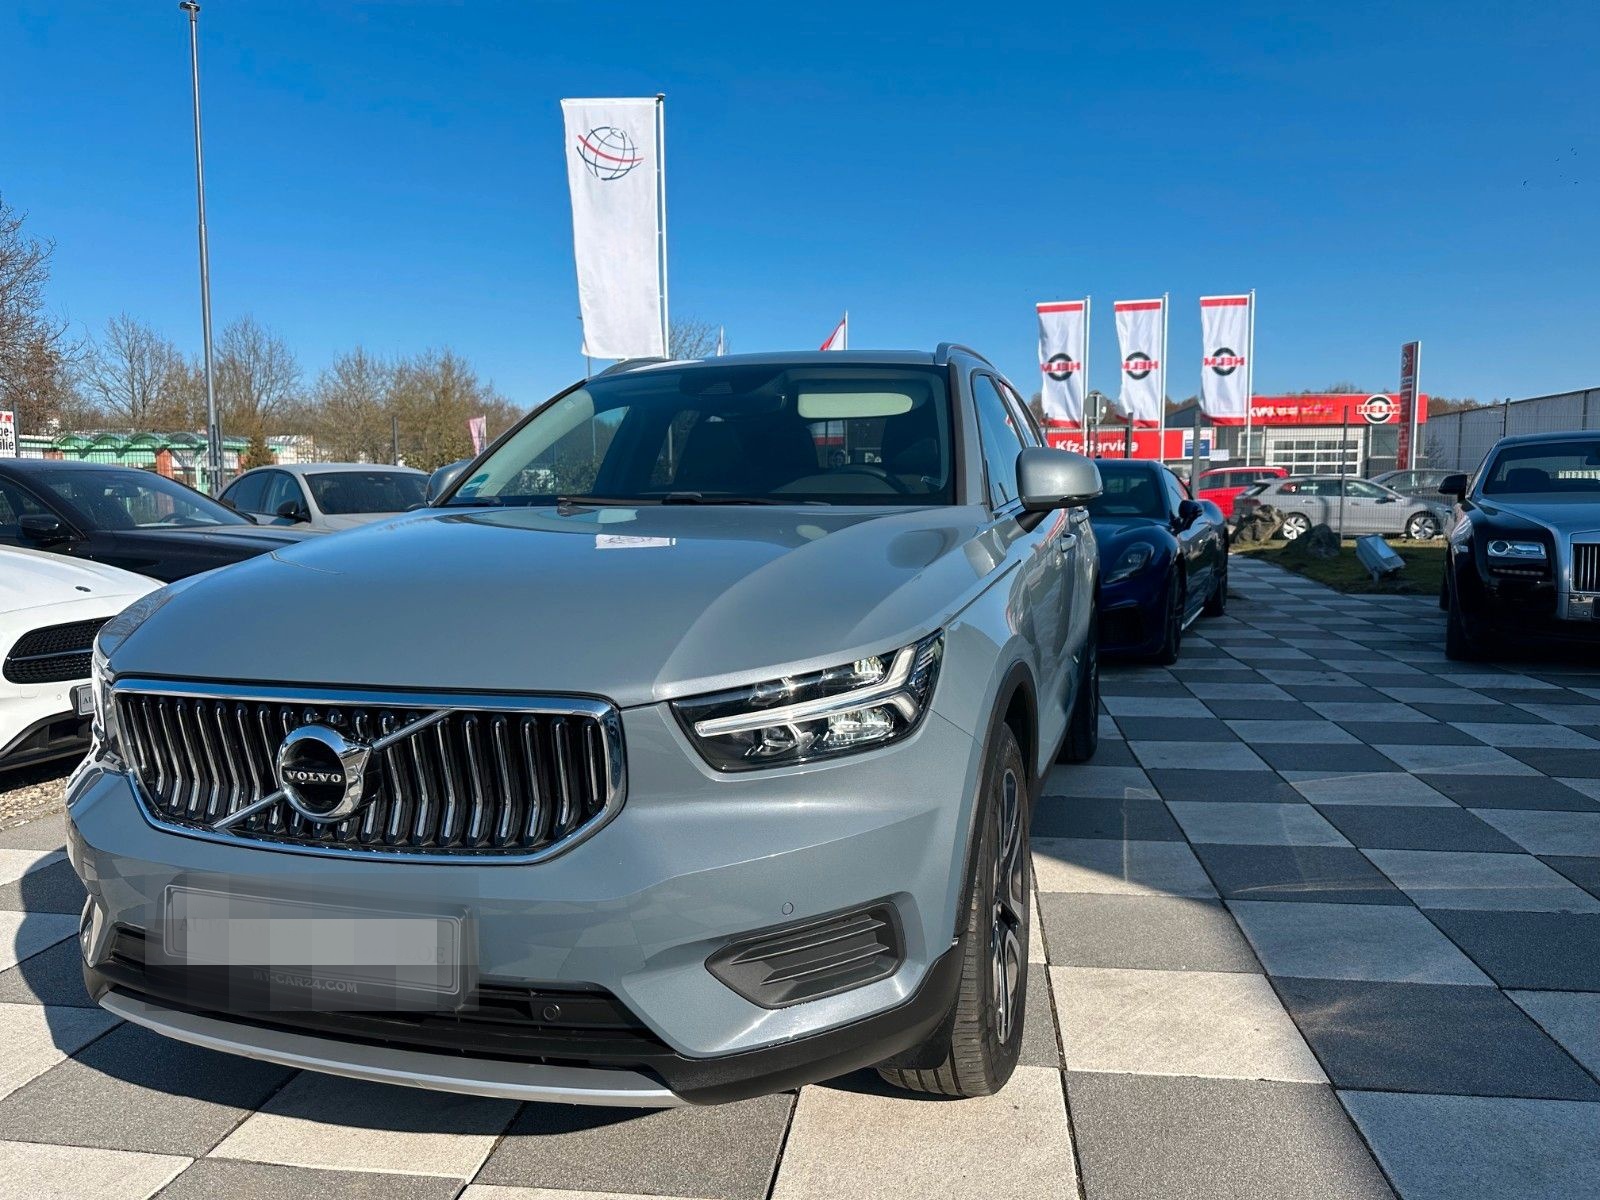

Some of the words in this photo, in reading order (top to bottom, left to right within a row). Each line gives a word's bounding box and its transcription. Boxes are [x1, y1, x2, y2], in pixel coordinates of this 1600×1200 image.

[1357, 403, 1401, 415] HELM
[1056, 439, 1139, 453] Kfz-ervie
[285, 769, 342, 783] VOLVO
[252, 968, 358, 994] MY-CAR24.COM
